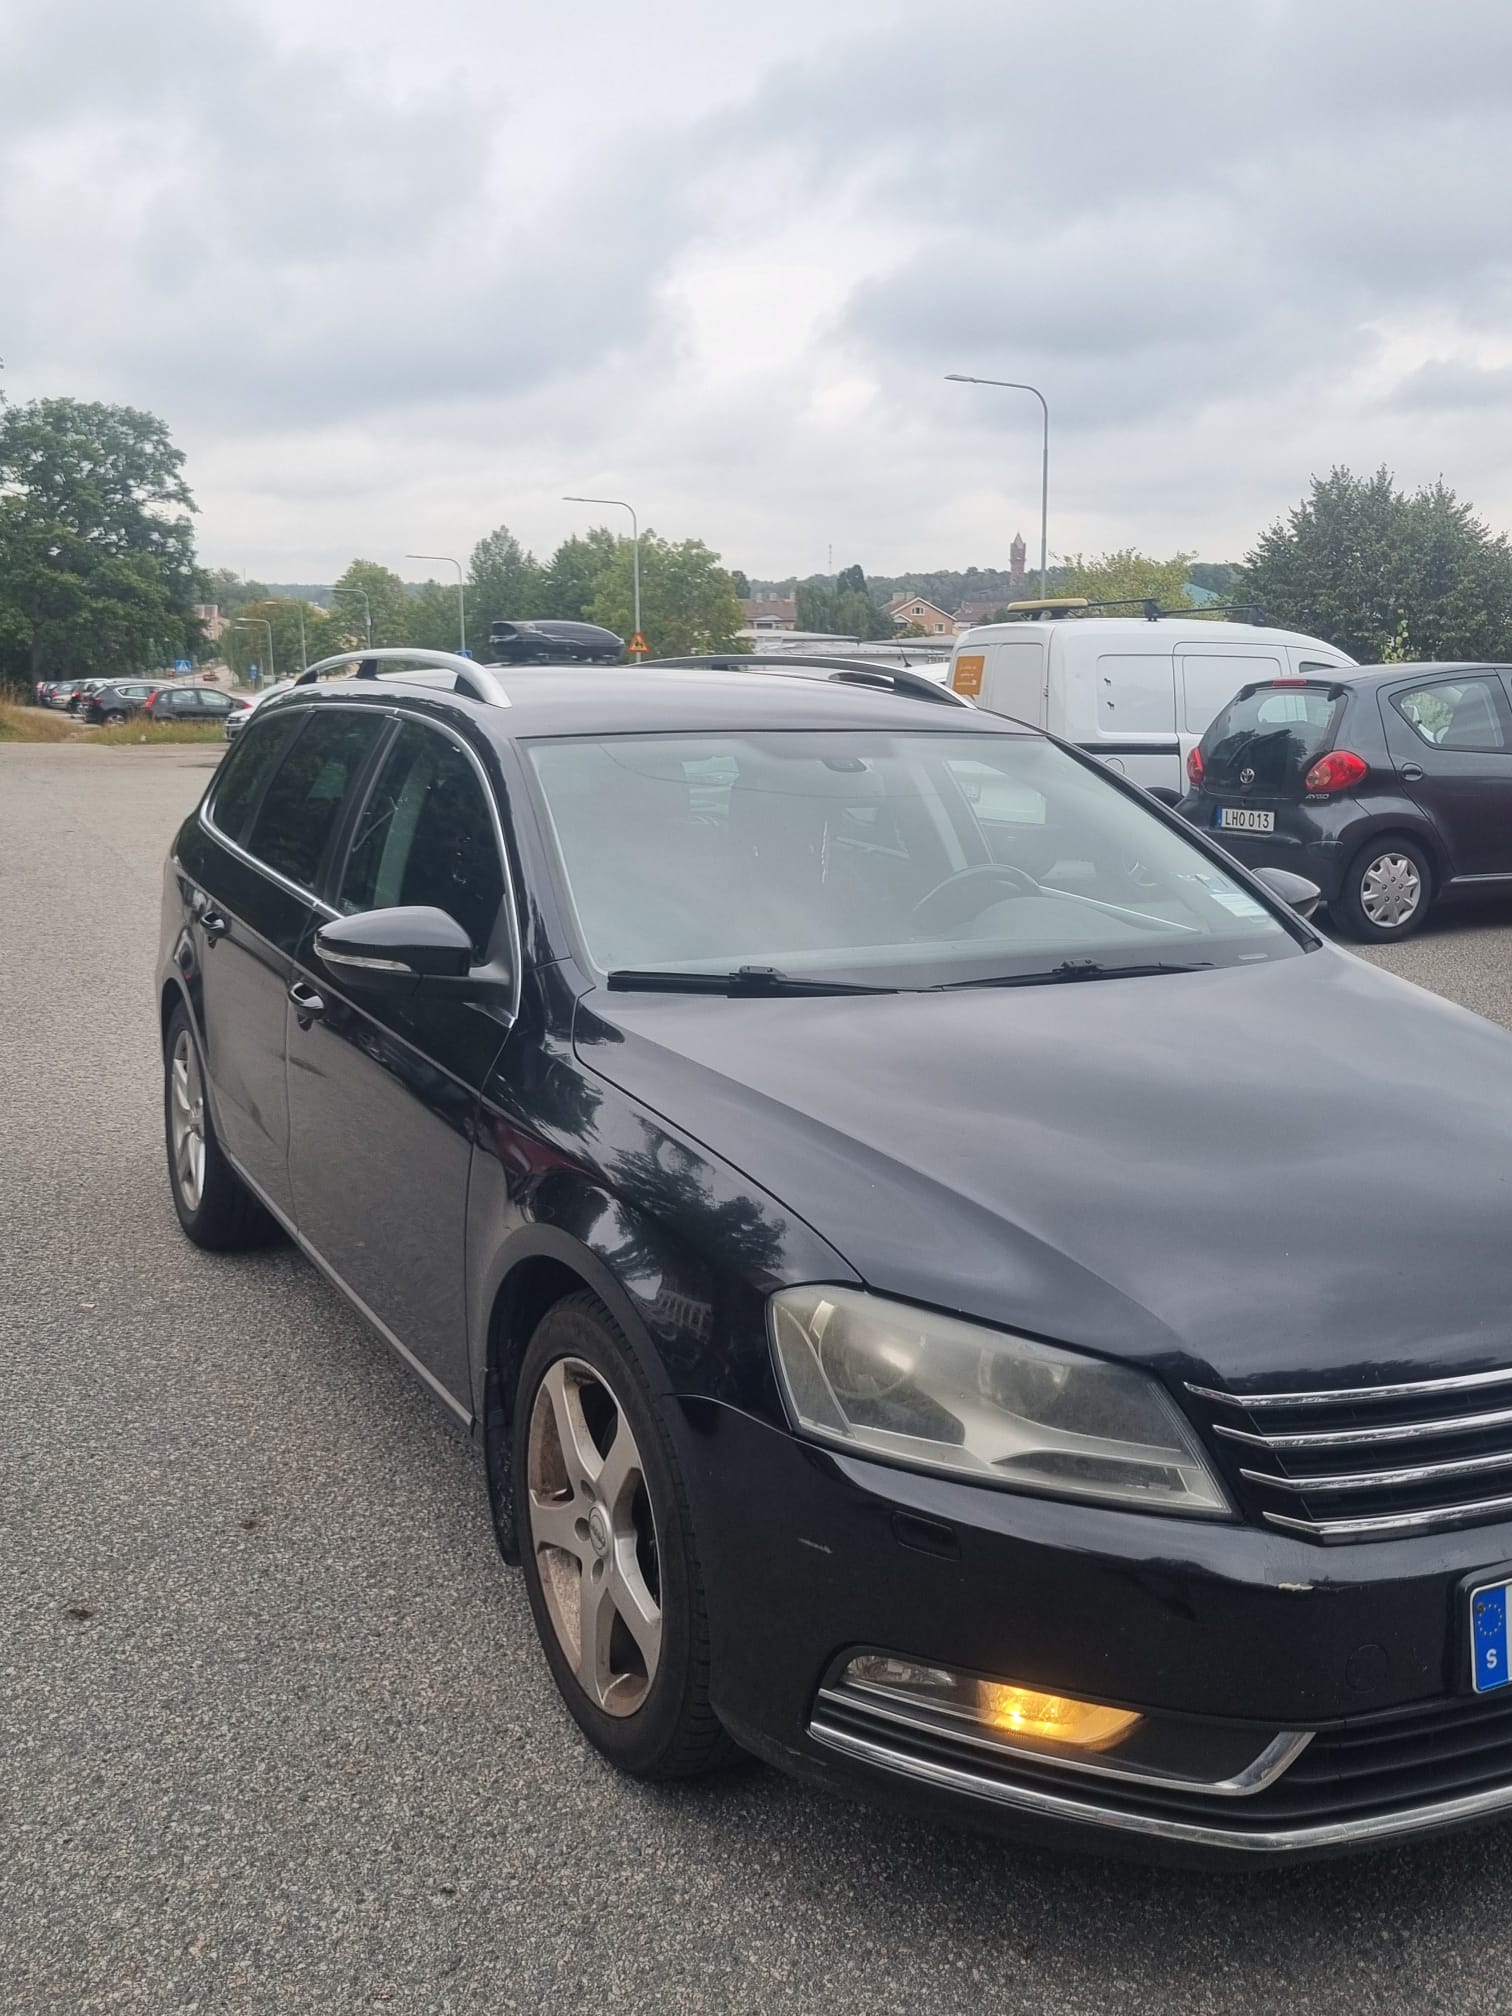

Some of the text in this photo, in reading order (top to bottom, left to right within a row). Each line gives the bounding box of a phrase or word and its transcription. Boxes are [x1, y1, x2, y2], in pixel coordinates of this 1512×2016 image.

[1225, 810, 1270, 829] LHO 013
[1486, 1648, 1498, 1669] S
